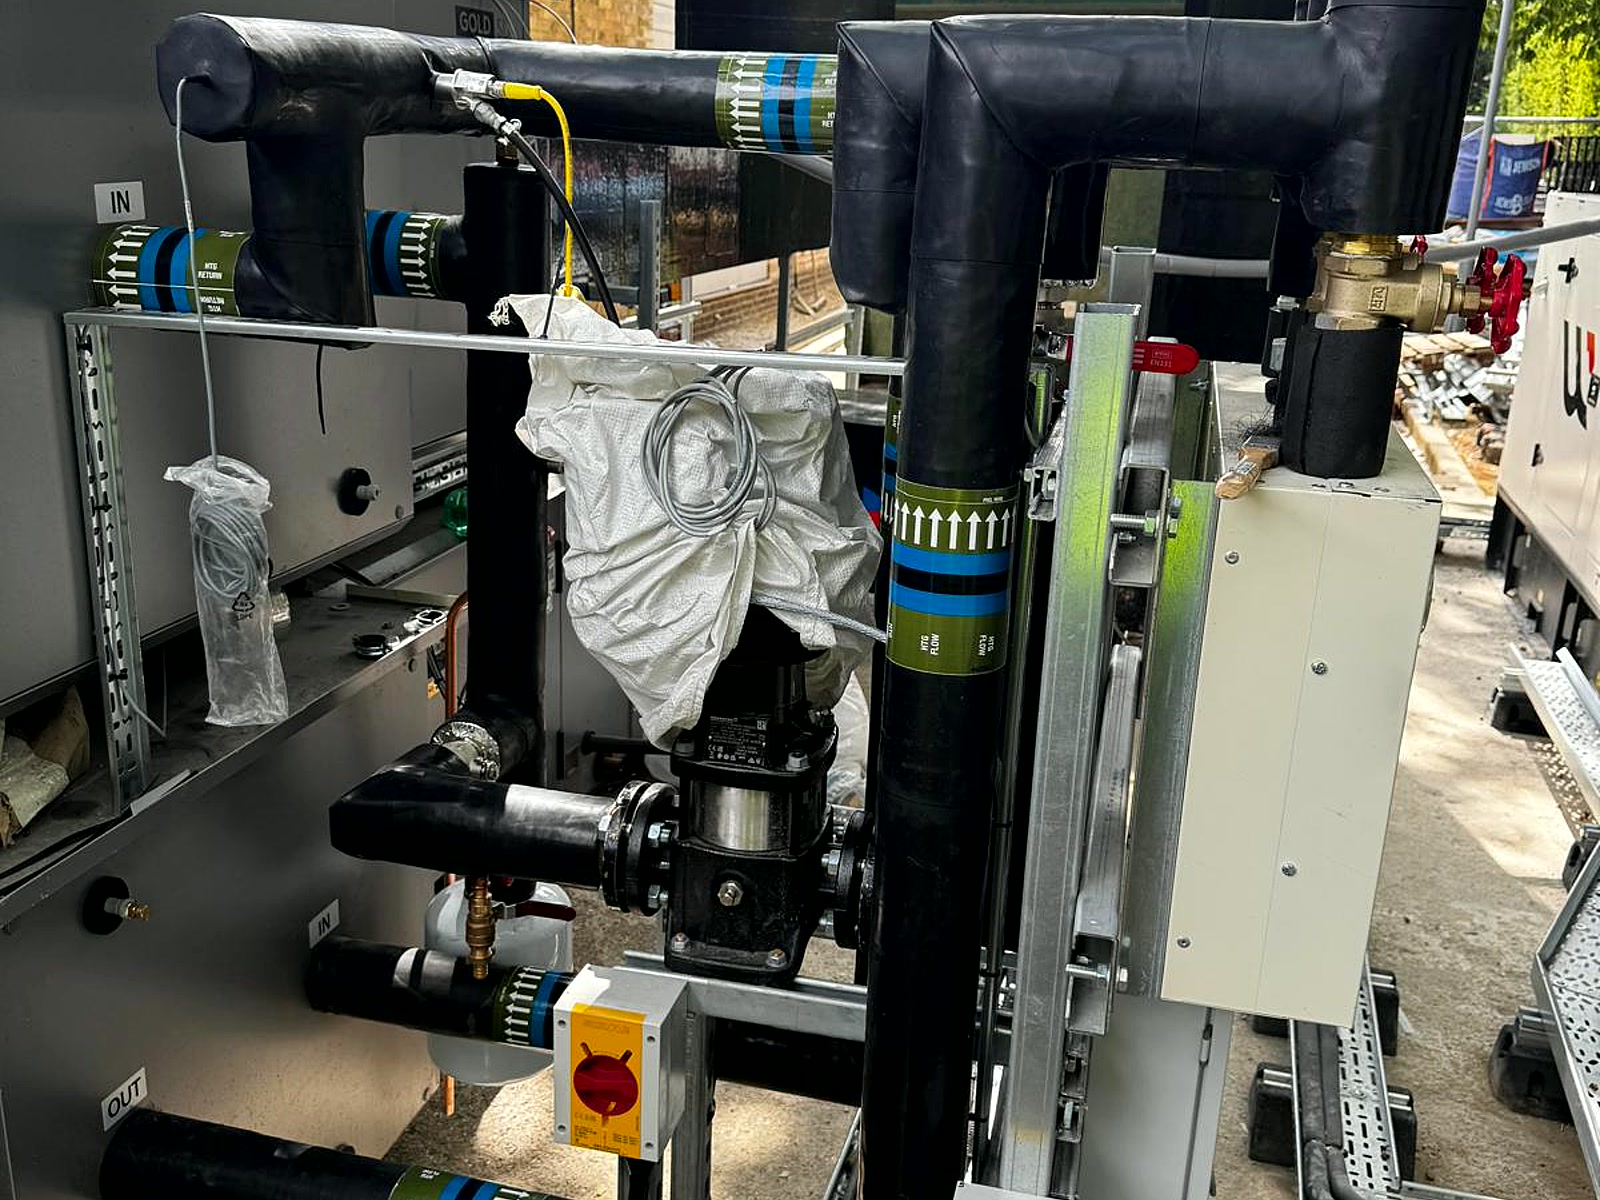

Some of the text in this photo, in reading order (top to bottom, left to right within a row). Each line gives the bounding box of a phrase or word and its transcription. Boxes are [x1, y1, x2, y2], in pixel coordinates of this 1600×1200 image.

[460, 11, 492, 35] GOLD
[110, 190, 131, 214] IN
[920, 634, 929, 651] HTG
[930, 633, 940, 656] FLOW
[318, 912, 330, 937] IN
[107, 1076, 141, 1118] OUT
